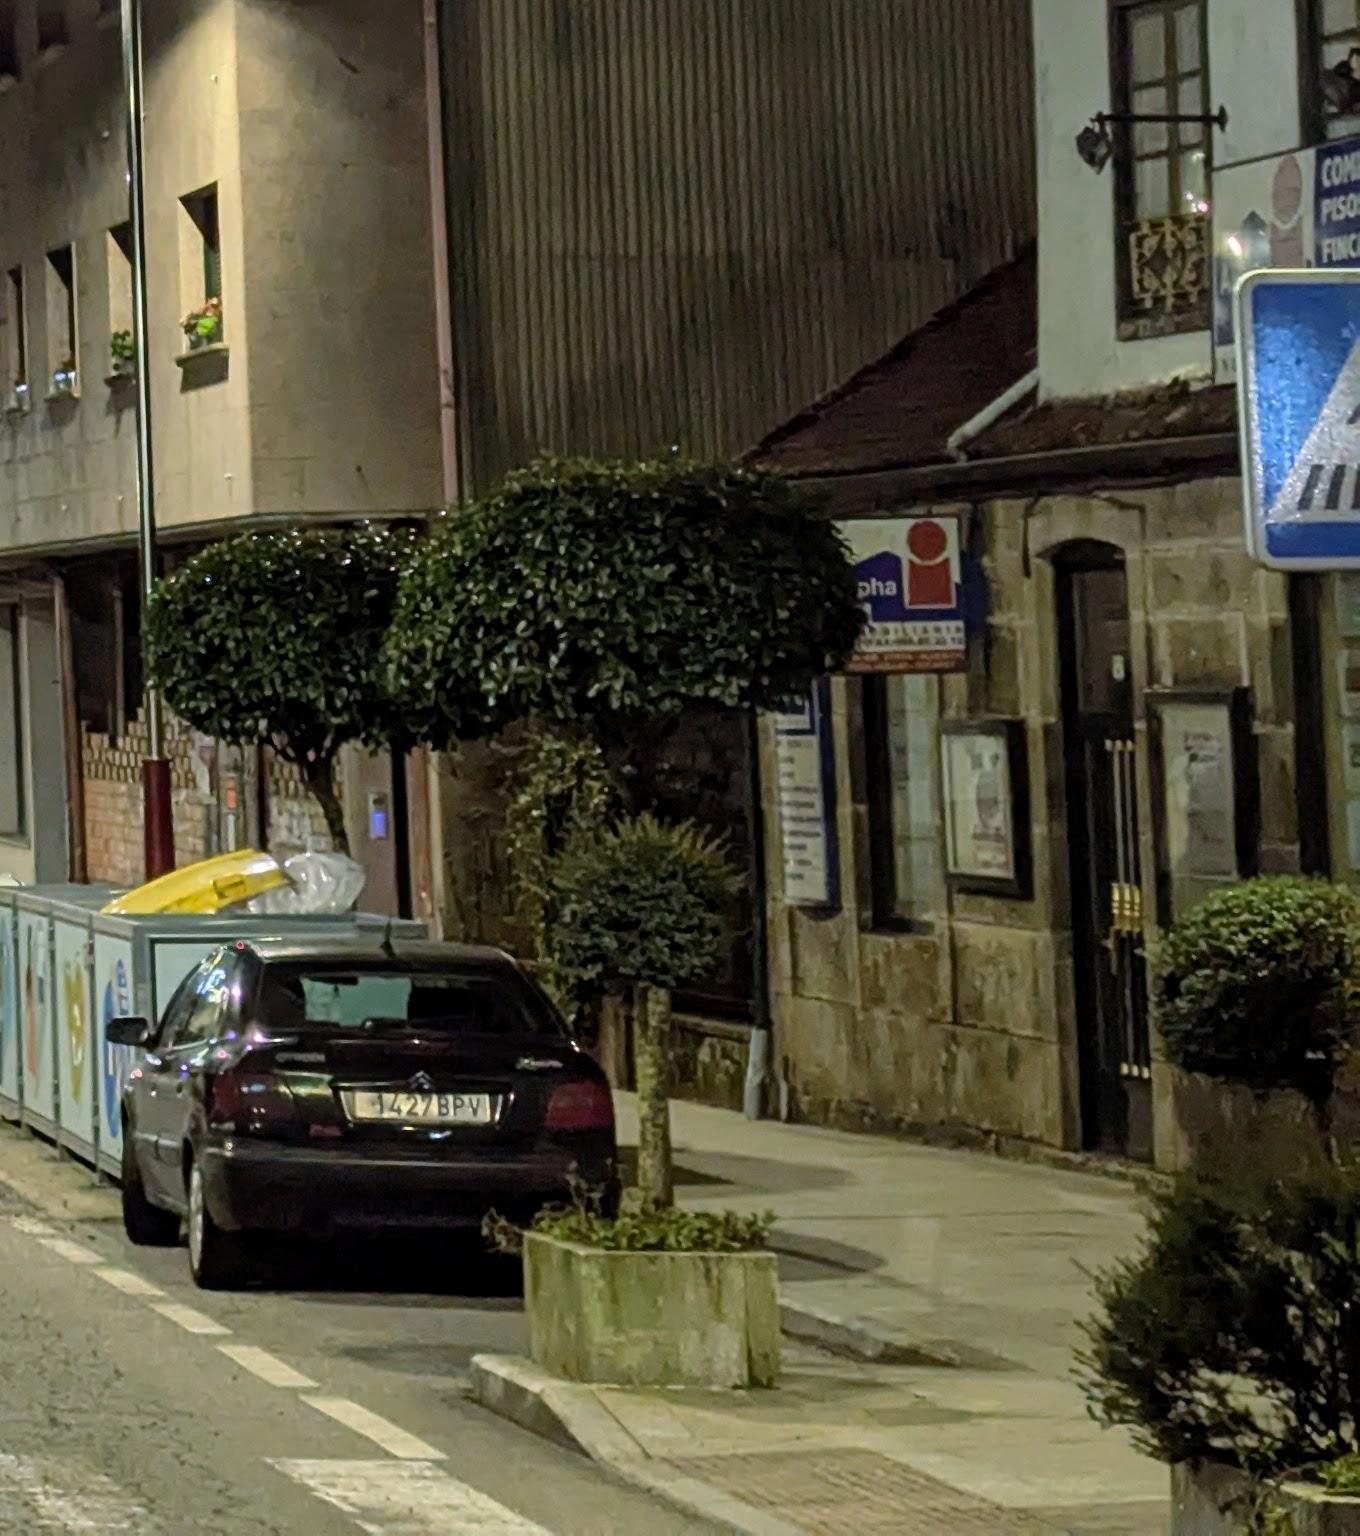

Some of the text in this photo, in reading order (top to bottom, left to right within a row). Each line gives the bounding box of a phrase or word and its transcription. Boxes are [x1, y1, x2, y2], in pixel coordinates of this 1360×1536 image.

[1321, 193, 1360, 225] PISO
[1322, 233, 1360, 263] FINC
[857, 576, 897, 599] pha
